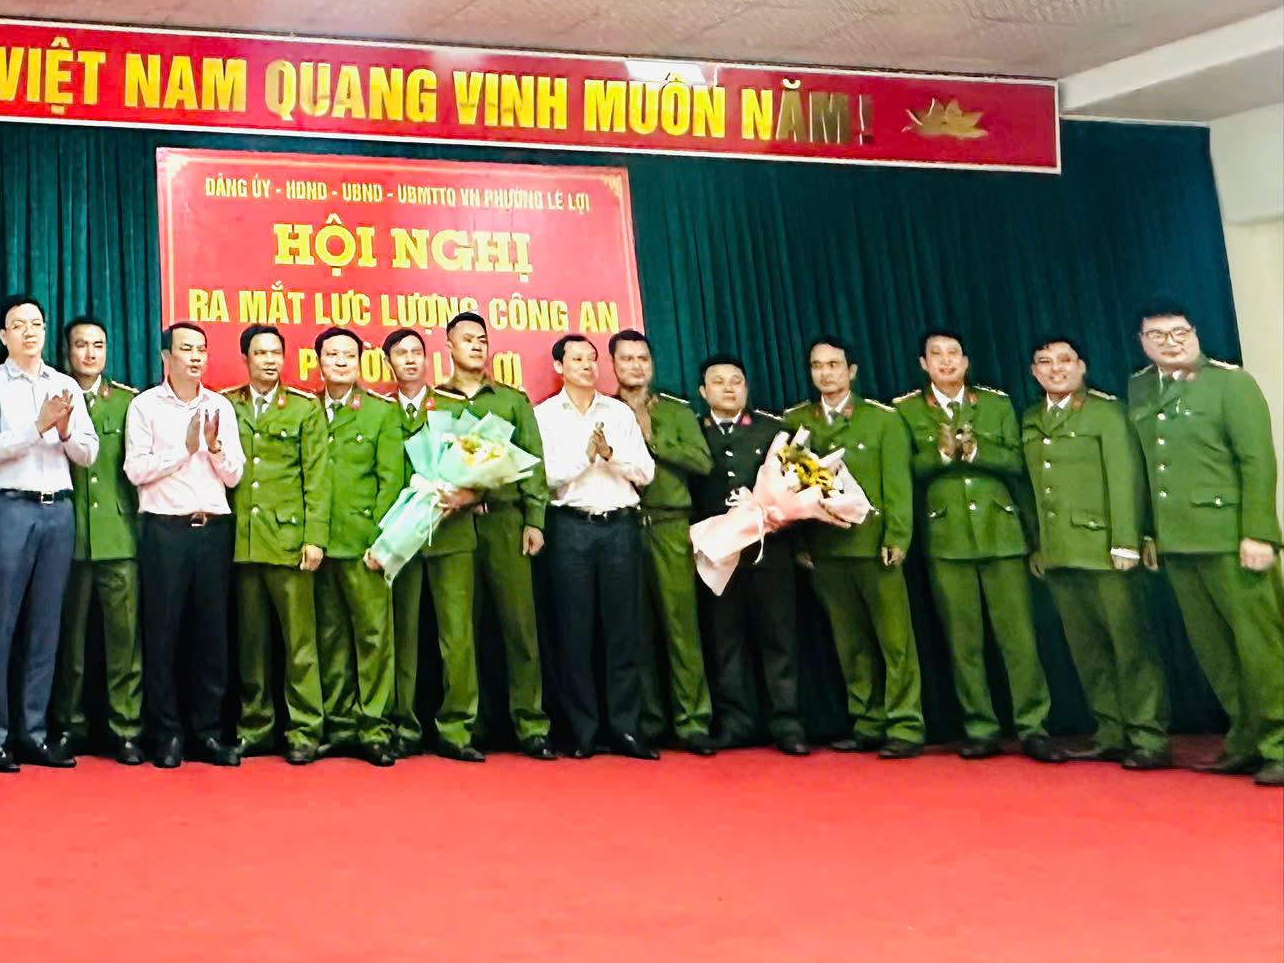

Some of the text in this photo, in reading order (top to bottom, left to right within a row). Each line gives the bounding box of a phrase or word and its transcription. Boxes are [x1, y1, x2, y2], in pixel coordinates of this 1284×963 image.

[124, 52, 247, 113] NAM
[264, 59, 437, 122] QUANG
[452, 70, 568, 130] VINH
[584, 73, 725, 139] MUÔN
[341, 182, 383, 203] UBND
[273, 213, 533, 283] HỘI NGHỊ
[188, 288, 230, 323] RA
[239, 280, 305, 325] MẮT
[489, 293, 569, 333] CÔNG
[579, 300, 620, 334] AN
